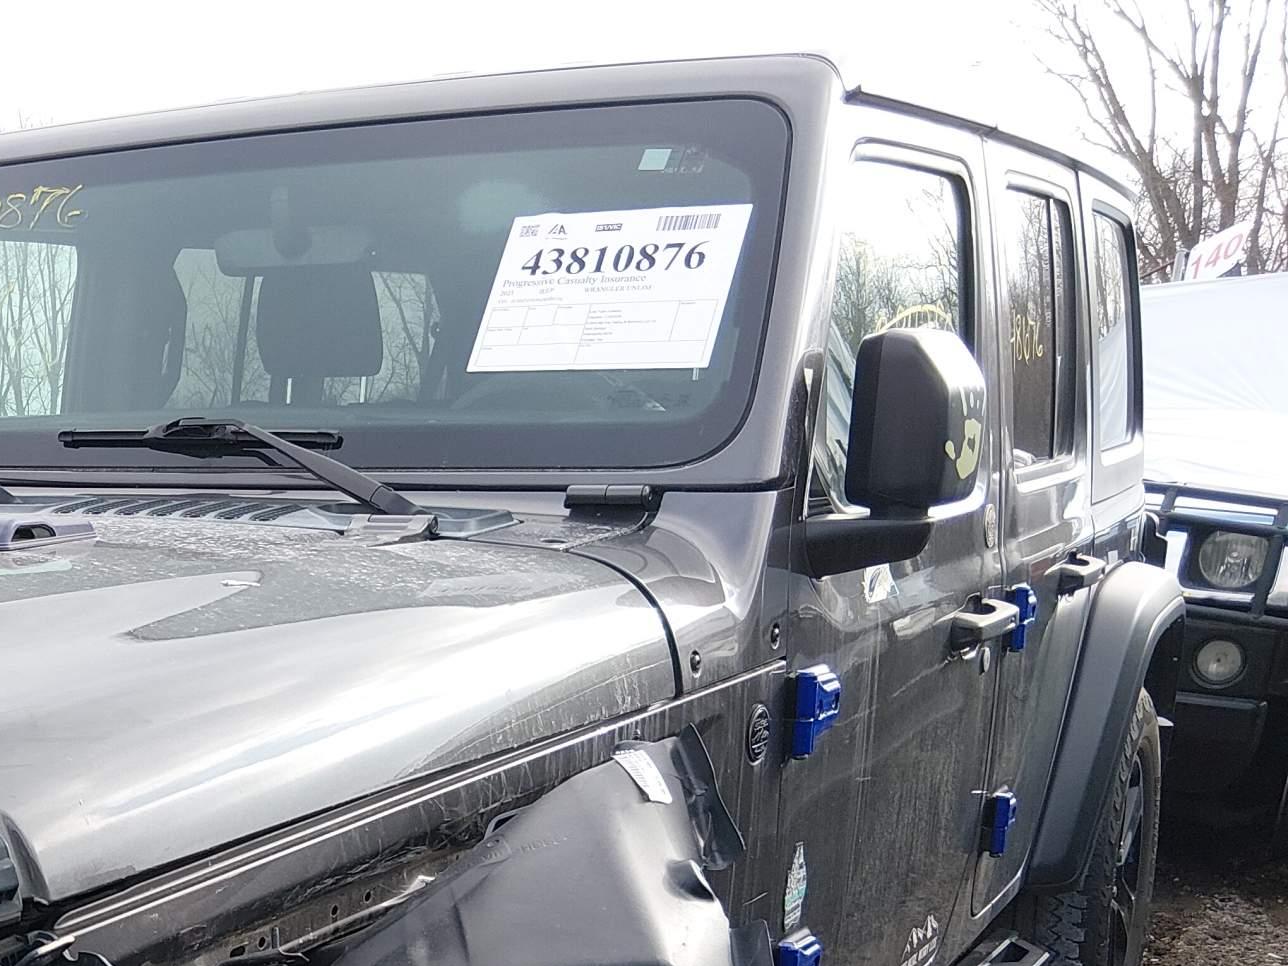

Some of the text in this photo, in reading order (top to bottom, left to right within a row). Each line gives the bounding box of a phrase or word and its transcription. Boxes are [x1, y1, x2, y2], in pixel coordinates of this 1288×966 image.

[520, 240, 710, 276] 43810876
[1191, 232, 1244, 280] 140
[502, 274, 648, 289] Progressive Casualty Insurance
